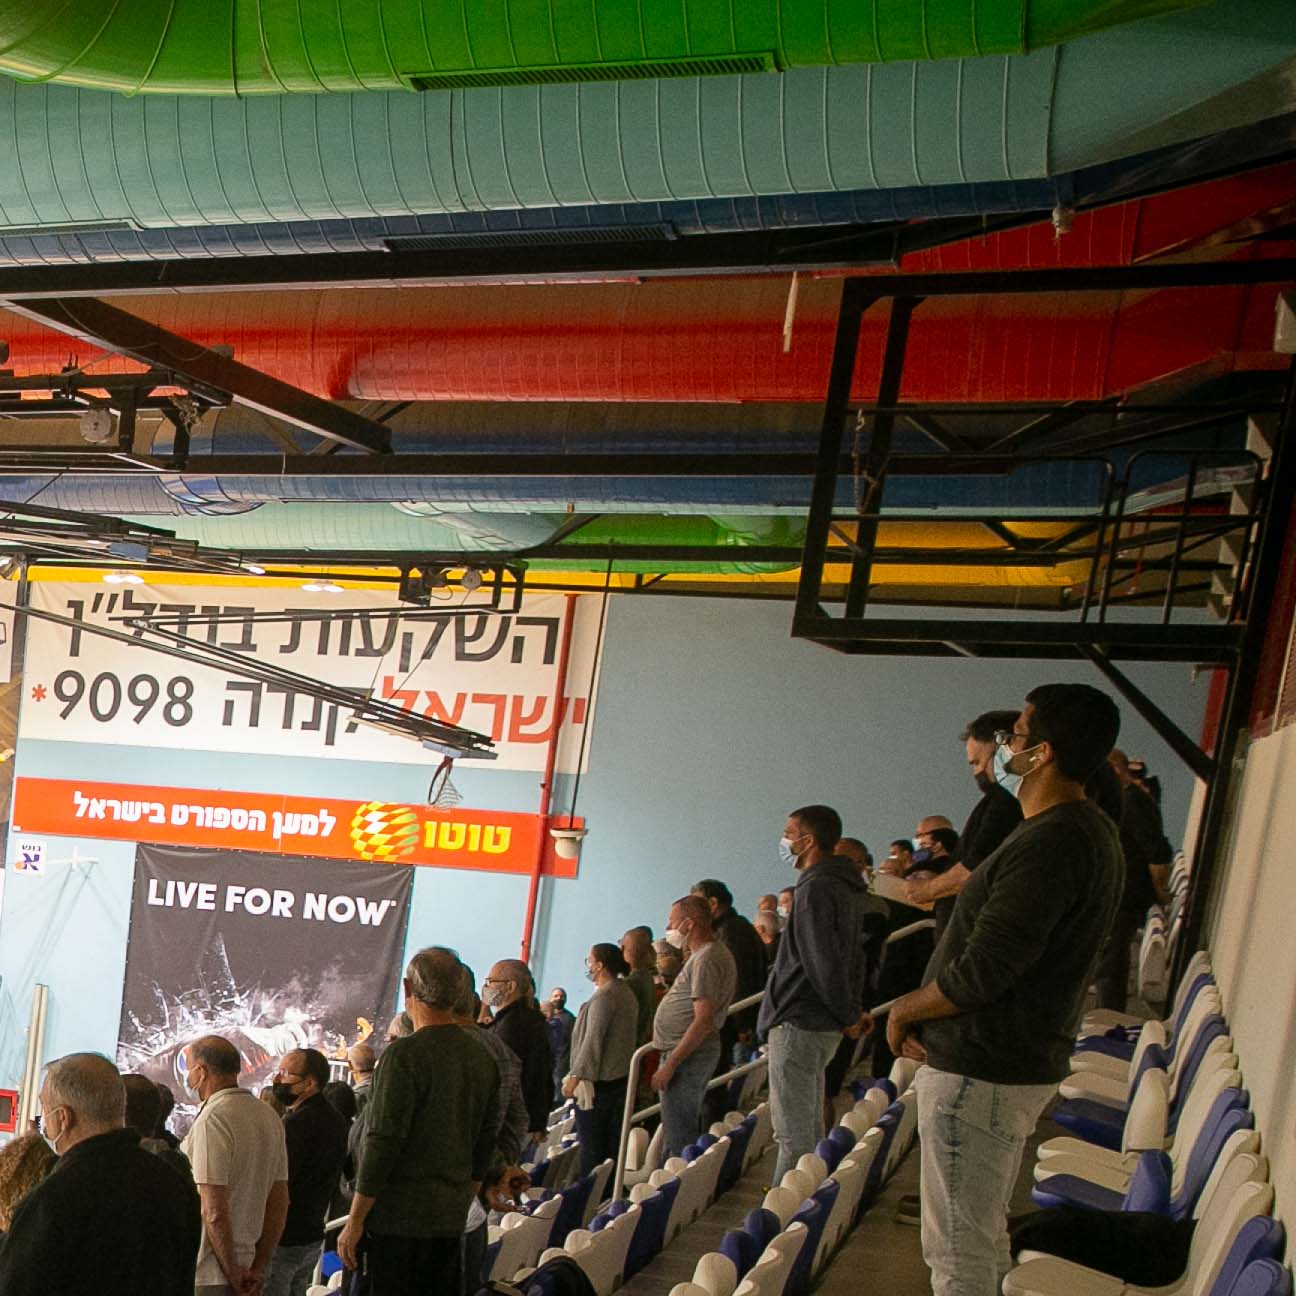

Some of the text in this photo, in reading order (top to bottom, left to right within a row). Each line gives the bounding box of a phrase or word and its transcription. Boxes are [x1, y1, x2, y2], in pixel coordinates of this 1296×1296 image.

[279, 604, 559, 674] השקעות
[73, 790, 336, 839] למען הספורט בישראל
[423, 818, 512, 854] טוטו
[147, 877, 389, 927] LIVE FOR NOW
